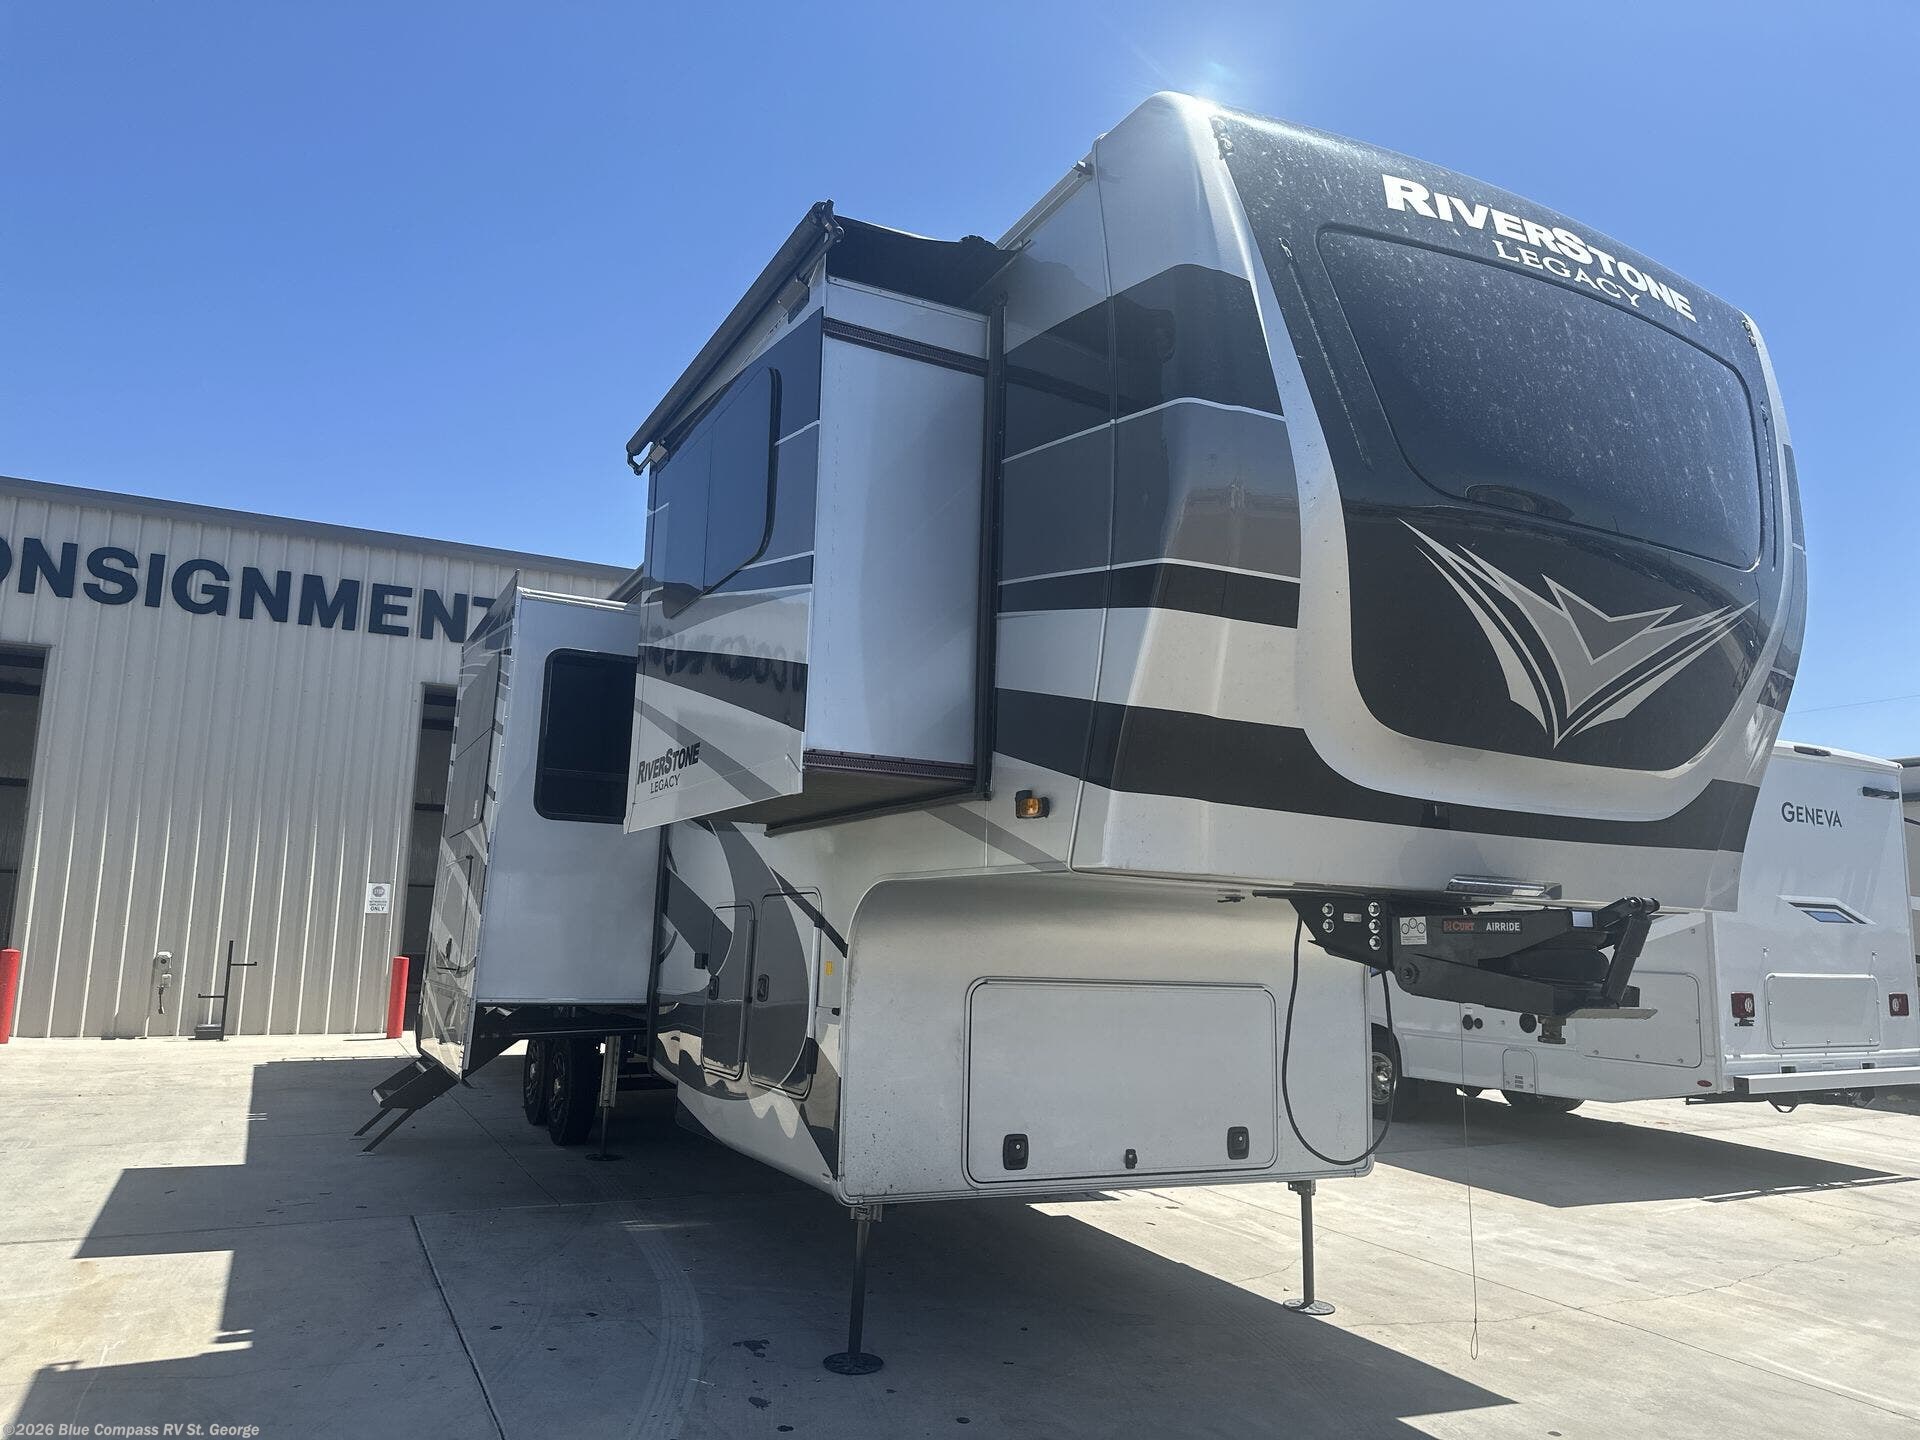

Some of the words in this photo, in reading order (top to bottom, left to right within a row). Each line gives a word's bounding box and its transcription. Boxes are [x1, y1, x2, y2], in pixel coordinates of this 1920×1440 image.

[1381, 174, 1697, 323] RIVERSTONE
[1491, 240, 1641, 308] LEGACY
[0, 536, 497, 643] NSIGNMEN
[650, 774, 680, 794] LEGACY
[1781, 802, 1842, 828] GENEVA
[1486, 922, 1520, 931] AIRRIDE
